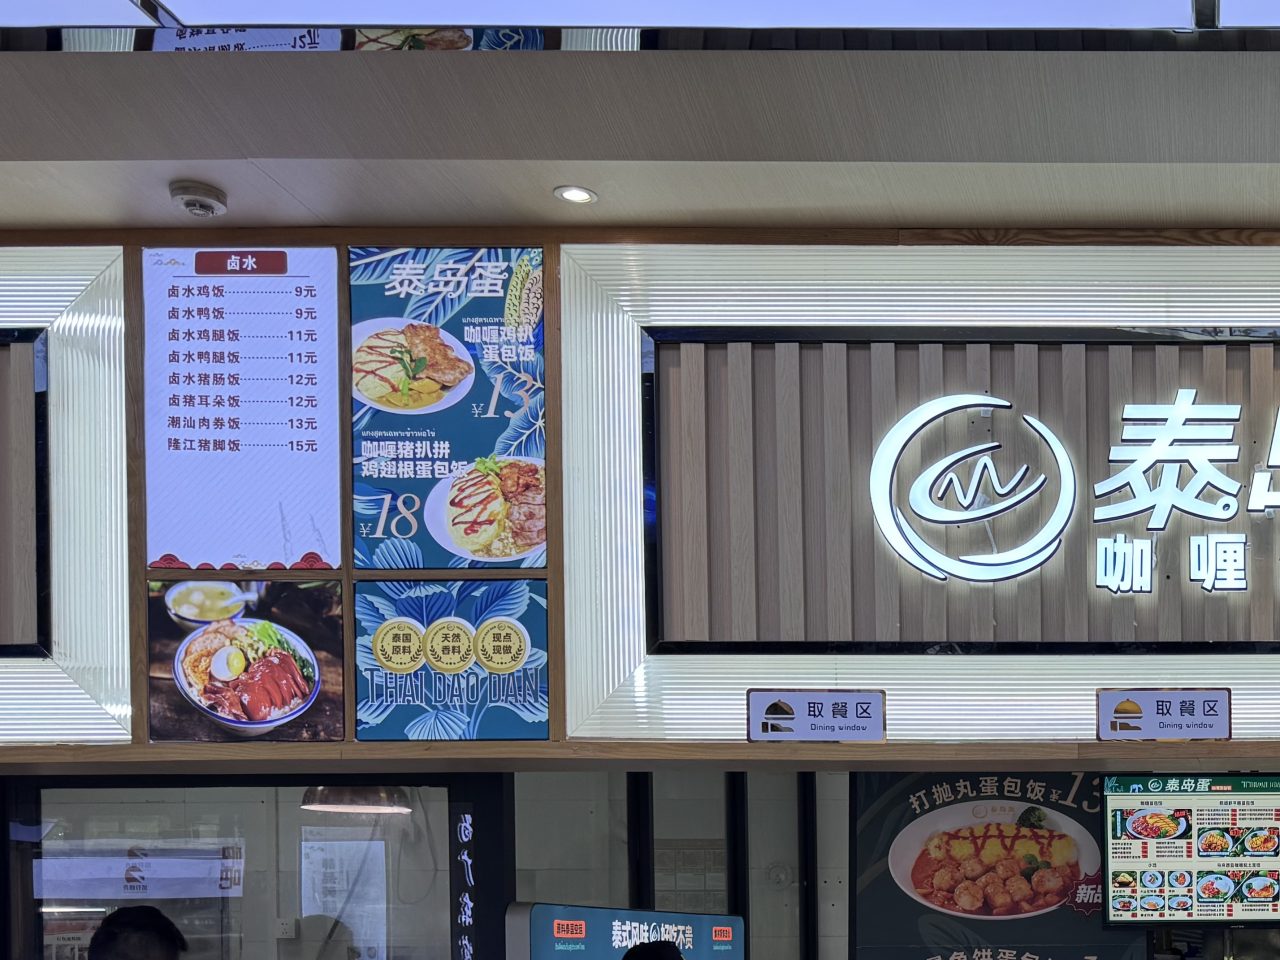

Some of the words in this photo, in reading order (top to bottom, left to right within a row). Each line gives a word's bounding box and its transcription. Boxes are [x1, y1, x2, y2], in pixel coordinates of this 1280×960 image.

[227, 255, 257, 271] 卤水
[385, 260, 508, 298] 泰岛蛋
[168, 285, 224, 298] 卤水鸡饭
[295, 286, 317, 298] 9元
[168, 307, 224, 320] 卤水鸭饭
[295, 308, 317, 320] 9元
[168, 329, 240, 342] 卤水鸡腿饭
[287, 330, 317, 342] 11元
[464, 325, 534, 343] 咖喱鸡扒
[168, 351, 240, 364] 卤水鸭腿饭
[287, 352, 317, 364] 11元
[483, 344, 535, 362] 蛋包饭
[168, 372, 240, 386] 卤水猪肠饭
[288, 373, 317, 386] 12元
[168, 394, 240, 408] 卤猪耳朵饭
[288, 395, 317, 408] 12元
[288, 417, 317, 429] 13元
[168, 438, 240, 451] 隆江猪脚饭
[288, 439, 317, 451] 15元
[361, 441, 450, 458] 咖喱猪扒拼
[360, 461, 468, 478] 鸡翅根蛋包饭
[392, 632, 413, 643] 泰国
[441, 632, 461, 643] 天然
[492, 632, 512, 643] 现点
[392, 645, 412, 655] 原料
[441, 645, 461, 655] 香料
[492, 645, 512, 655] 现做
[364, 667, 425, 704] THAI
[432, 671, 480, 704] DAO
[488, 667, 541, 704] DAN
[807, 700, 873, 719] 取餐区
[1155, 699, 1219, 717] 取餐区
[810, 722, 835, 733] Dining
[837, 723, 868, 731] window
[1158, 721, 1183, 731] Dining
[1185, 721, 1215, 730] window
[1165, 778, 1212, 792] 泰岛蛋
[908, 775, 1047, 814] 打抛丸蛋包饭
